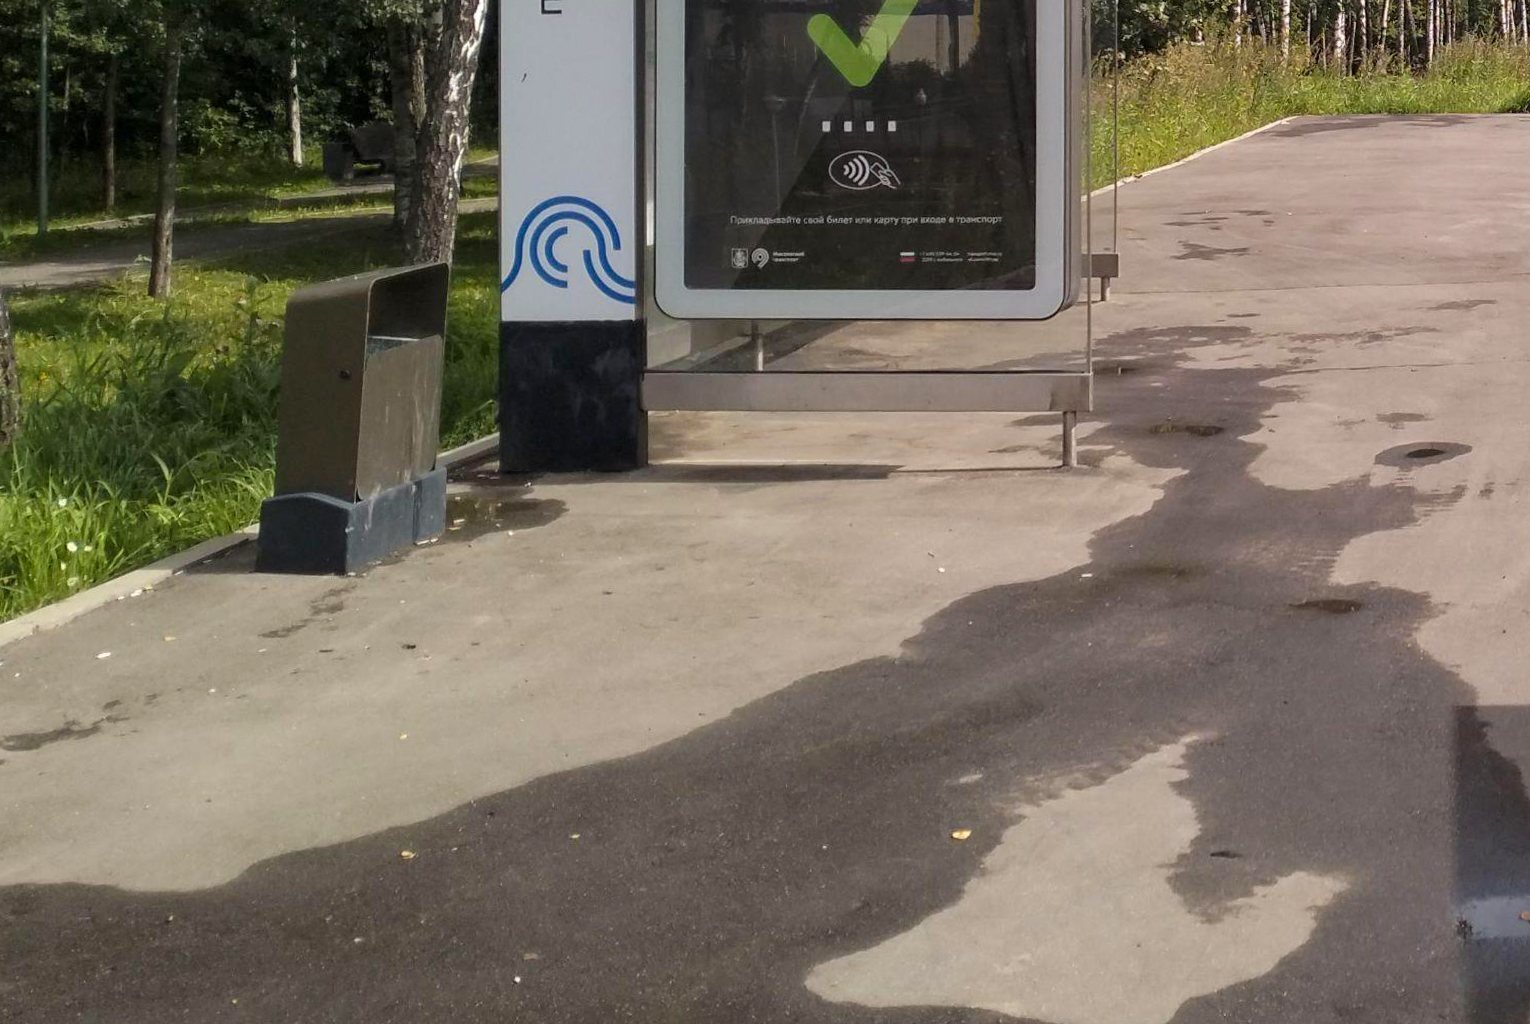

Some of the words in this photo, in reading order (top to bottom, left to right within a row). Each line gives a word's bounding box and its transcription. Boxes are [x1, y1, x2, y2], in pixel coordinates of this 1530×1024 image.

[826, 214, 853, 224] билет
[855, 216, 872, 224] или
[874, 216, 899, 225] карту
[956, 215, 1002, 225] транспорт
